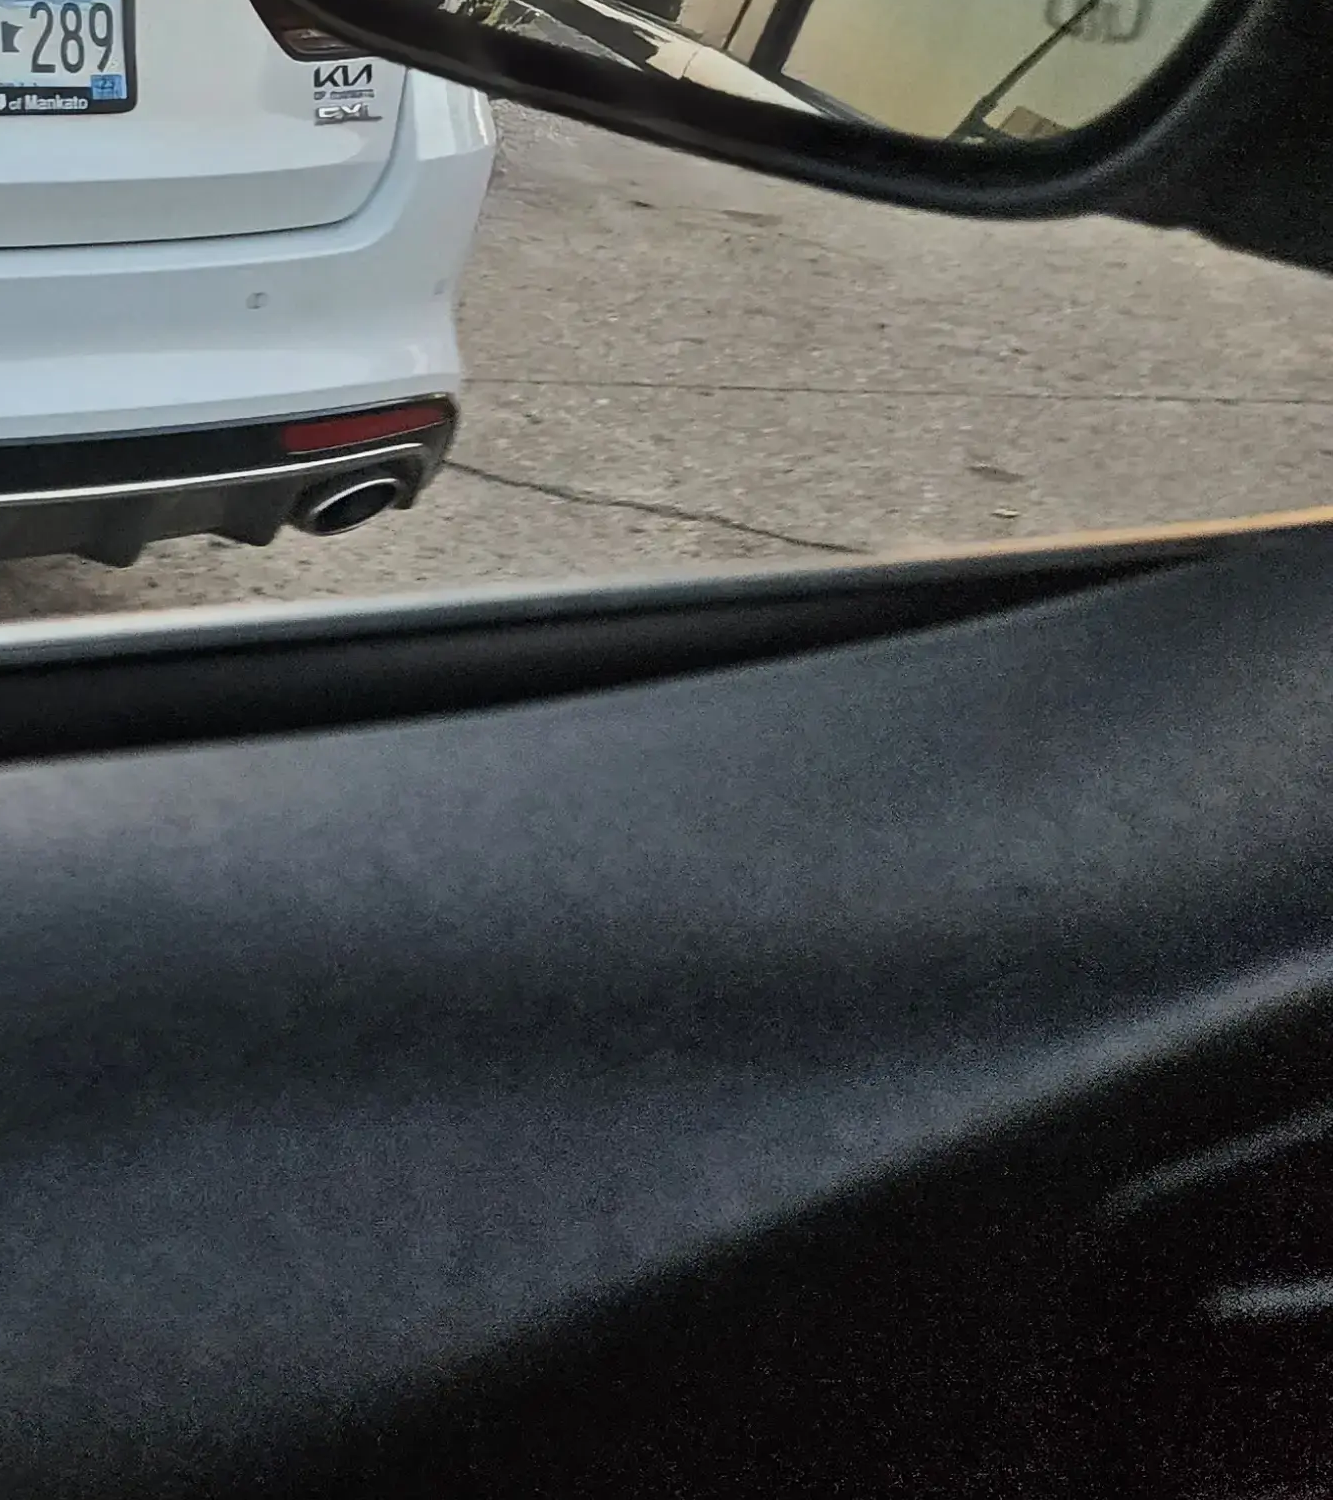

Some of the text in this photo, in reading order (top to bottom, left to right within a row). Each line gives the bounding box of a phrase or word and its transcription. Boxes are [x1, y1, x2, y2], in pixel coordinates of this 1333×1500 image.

[29, 2, 114, 74] 289
[314, 64, 372, 88] KIA
[24, 94, 88, 110] Mankato
